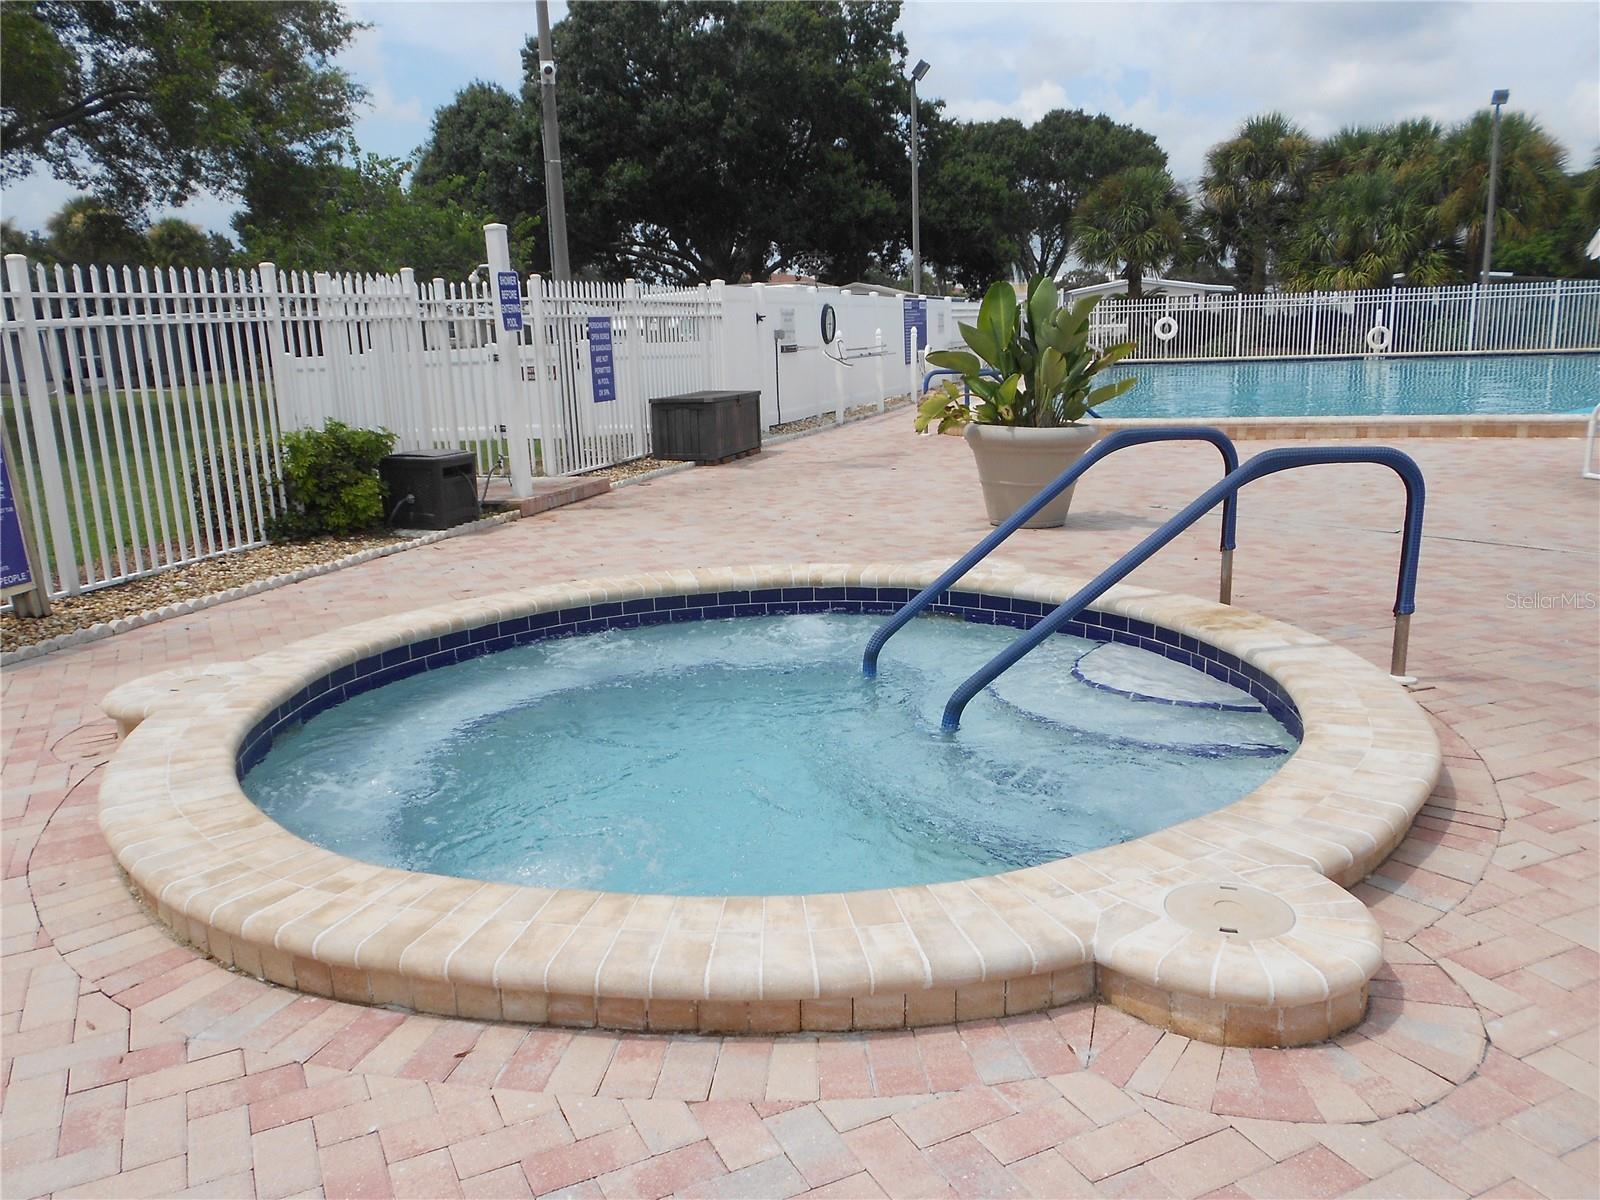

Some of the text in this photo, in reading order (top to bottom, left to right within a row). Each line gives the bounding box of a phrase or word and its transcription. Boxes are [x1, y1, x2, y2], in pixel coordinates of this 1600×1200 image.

[500, 276, 518, 285] SHOWER
[502, 290, 519, 299] BEFORE
[502, 304, 521, 313] ENTERING
[506, 318, 519, 327] POOL
[0, 572, 28, 585] PEOPLE
